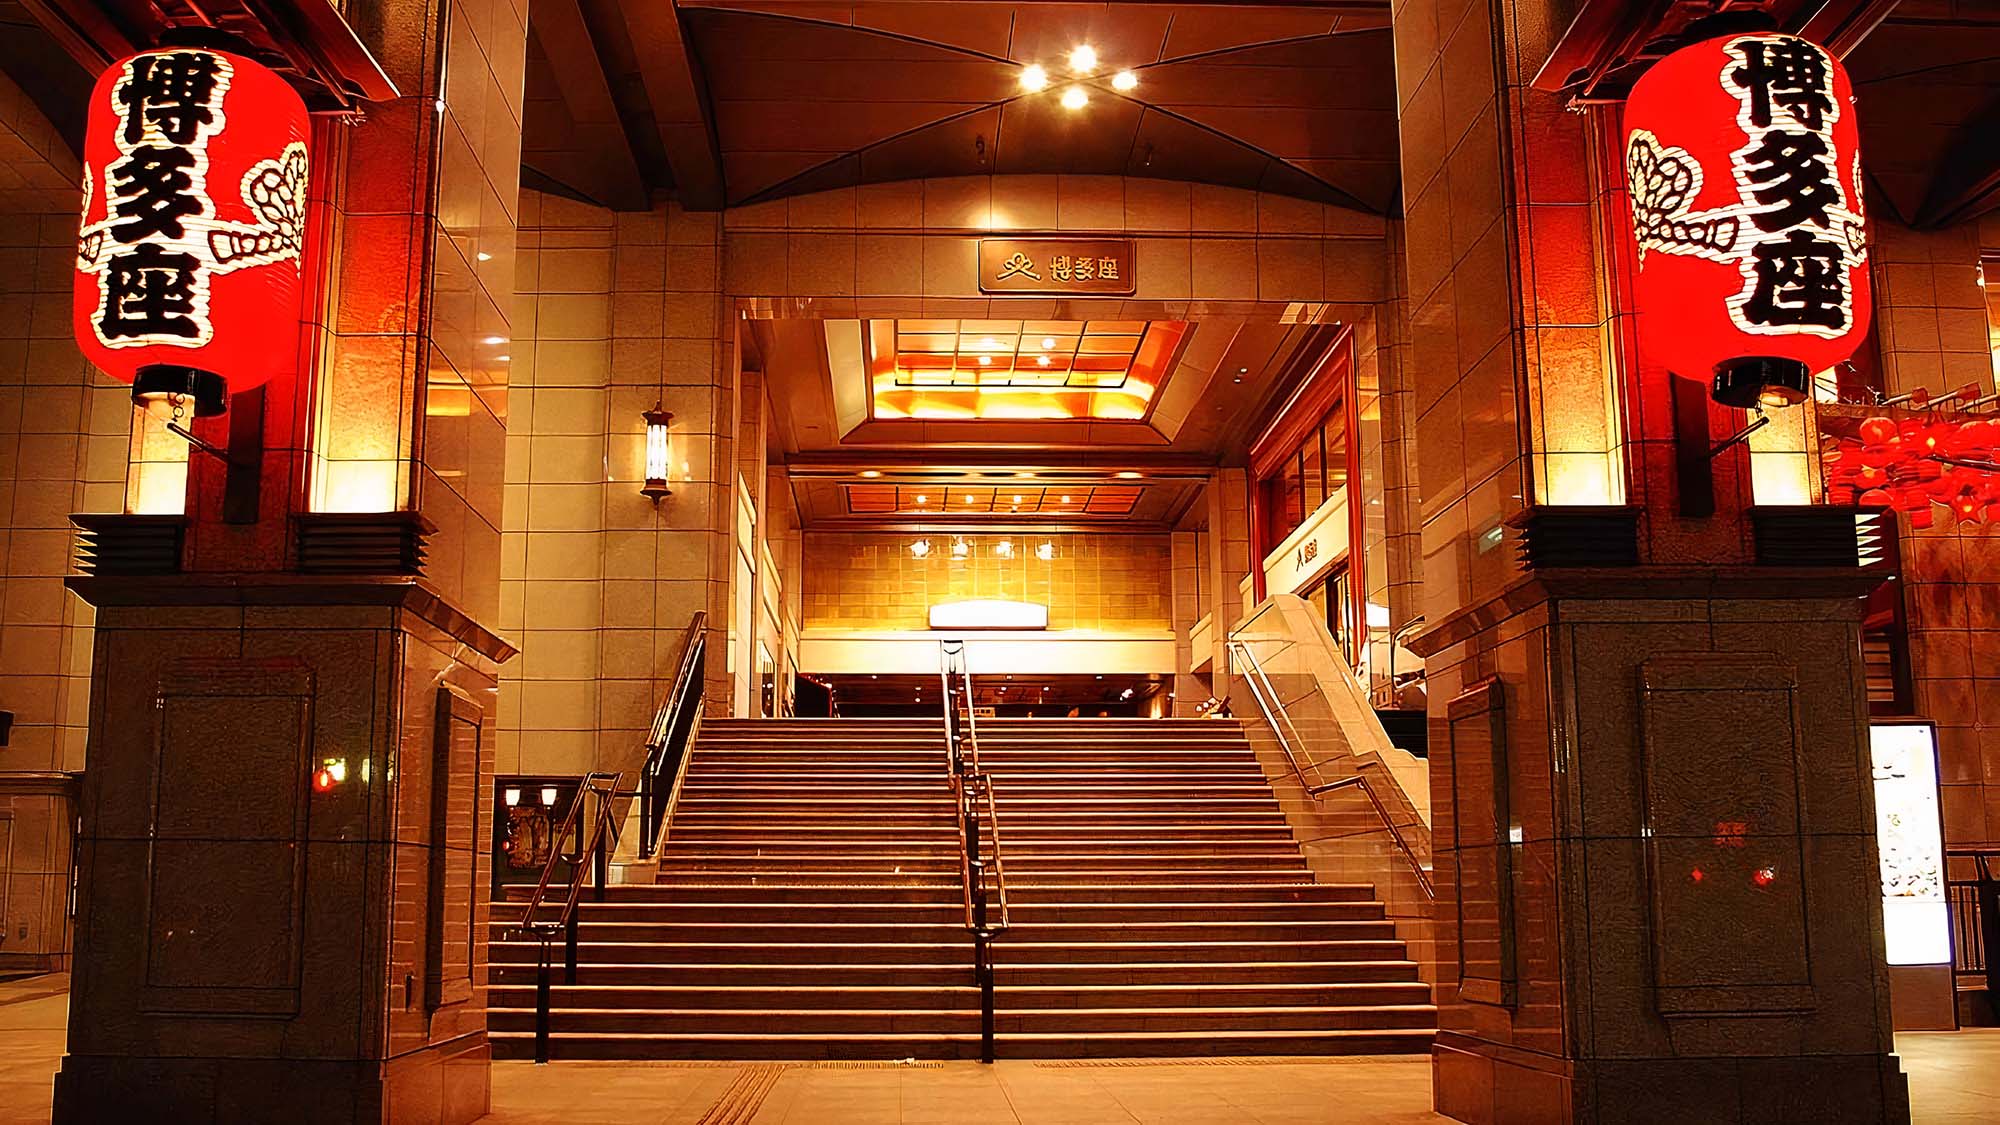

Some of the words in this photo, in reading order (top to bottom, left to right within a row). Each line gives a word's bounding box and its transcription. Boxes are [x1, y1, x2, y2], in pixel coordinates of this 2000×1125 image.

[99, 53, 222, 339] 博多座
[1049, 255, 1120, 281] 博多座
[1731, 36, 1848, 330] 博多座
